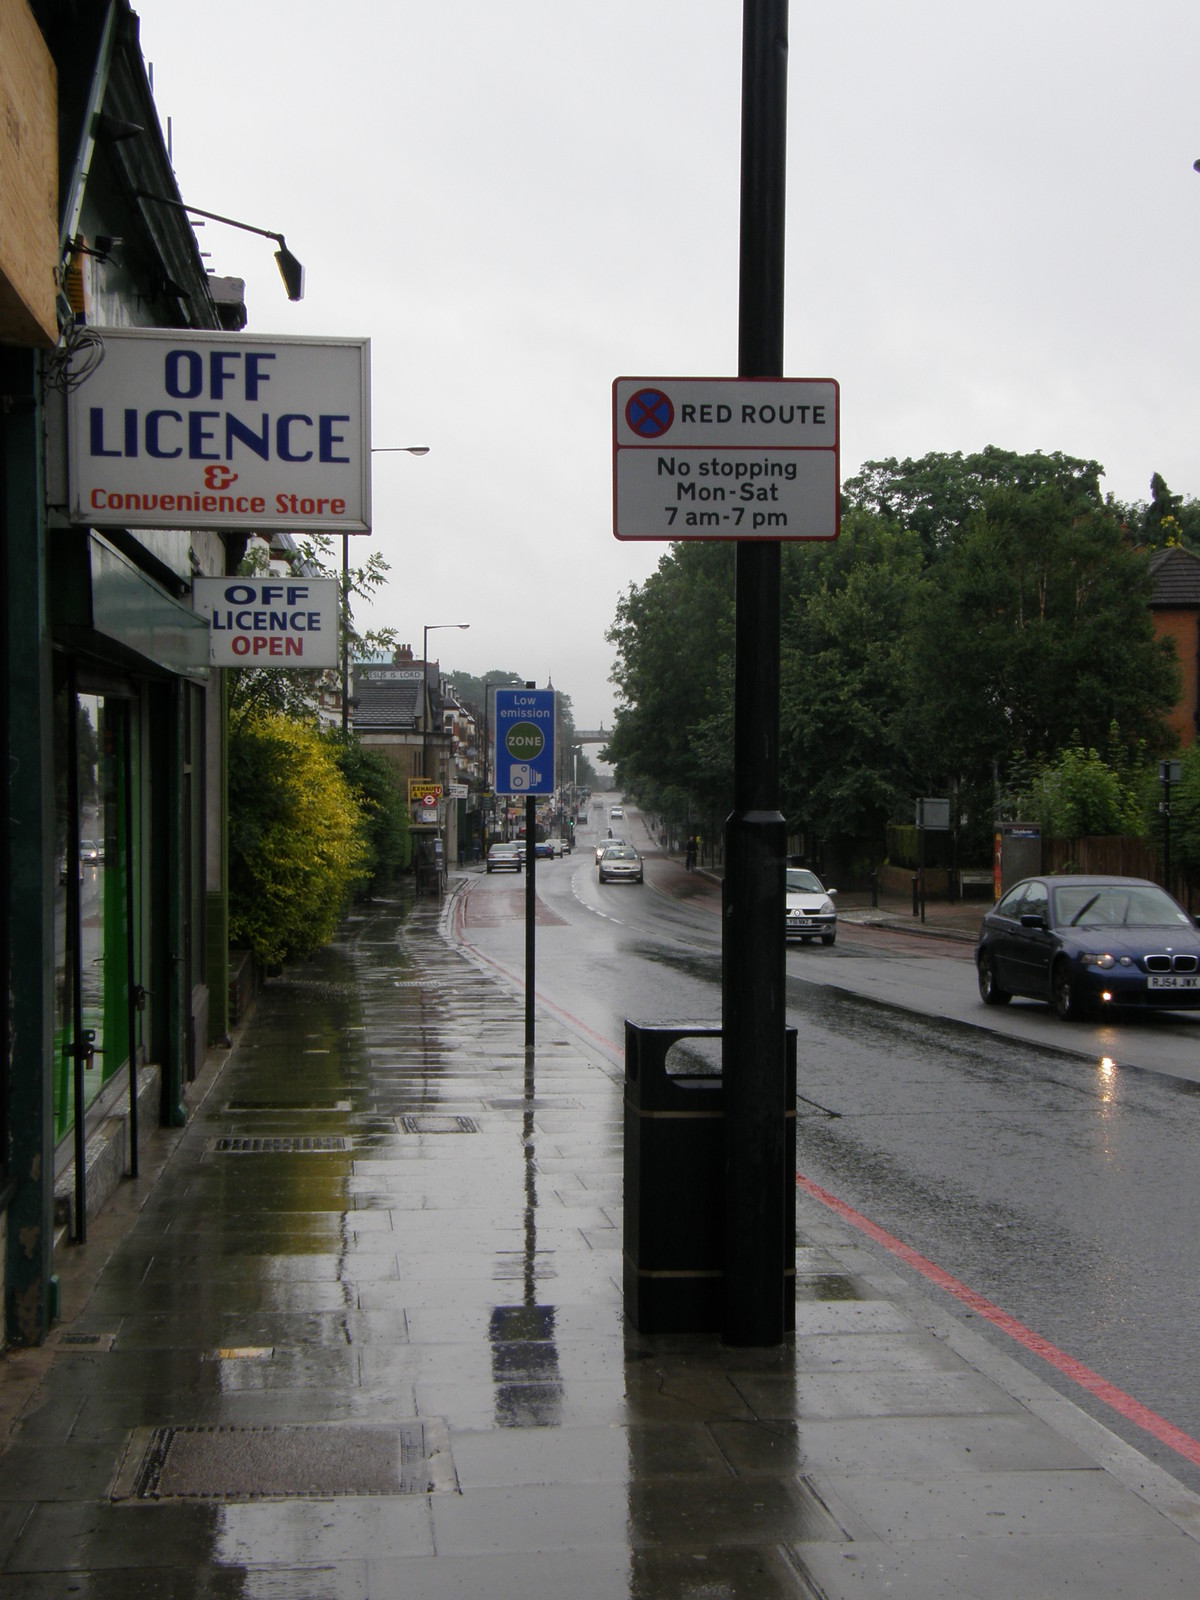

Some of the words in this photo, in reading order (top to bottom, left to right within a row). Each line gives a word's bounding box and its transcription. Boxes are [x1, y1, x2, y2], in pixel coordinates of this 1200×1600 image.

[164, 349, 276, 402] OFF
[681, 404, 732, 423] RED
[741, 404, 826, 425] ROUTE
[90, 407, 350, 464] LICENCE
[204, 464, 238, 491] &
[657, 457, 691, 476] No
[698, 458, 797, 480] stopping
[90, 488, 265, 514] Convenience
[275, 493, 346, 515] Store
[664, 507, 678, 526] 7
[752, 512, 788, 529] pm
[223, 585, 309, 606] OFF
[212, 610, 321, 632] LICENCE
[231, 635, 304, 657] OPEN
[368, 671, 387, 679] ESUS
[390, 671, 396, 679] IS
[400, 671, 421, 679] LORD
[513, 695, 536, 705] Low
[500, 707, 550, 718] emission
[508, 736, 541, 746] ZONE
[1152, 977, 1177, 987] RJ54
